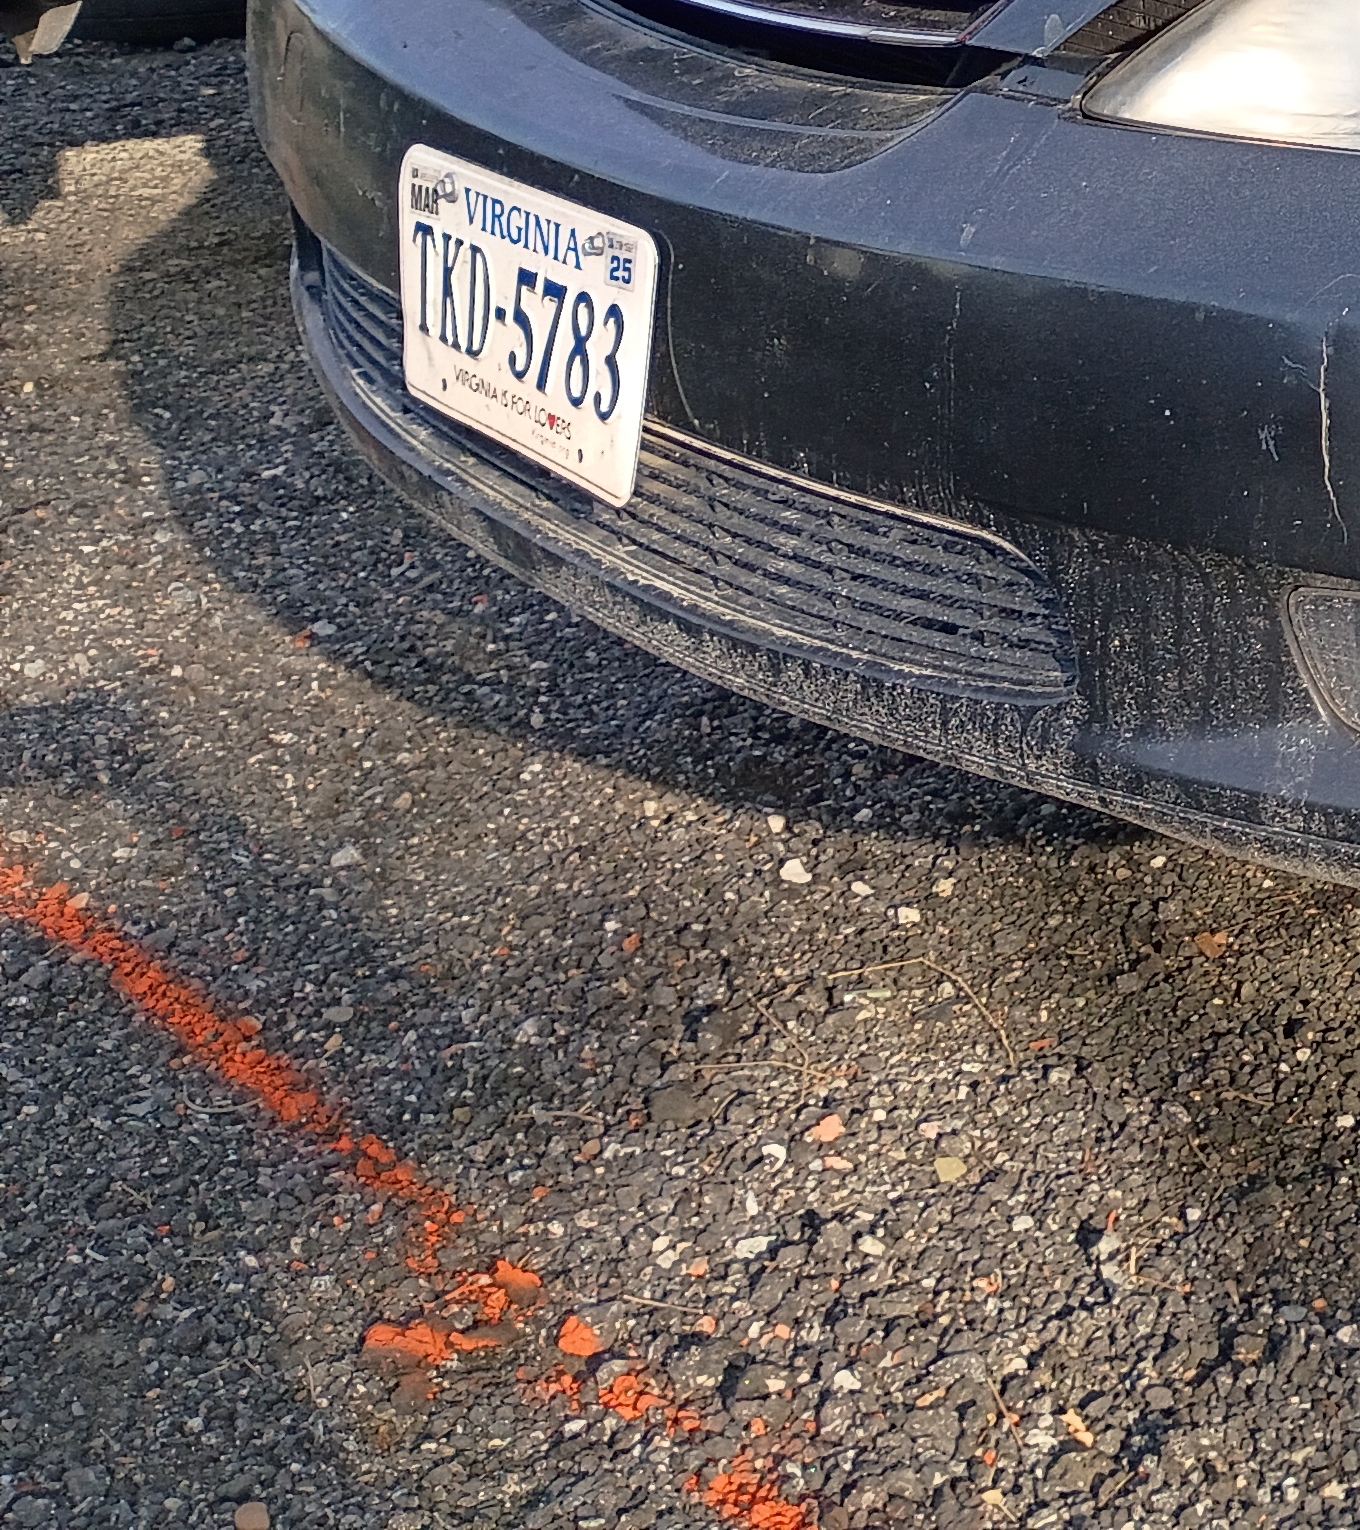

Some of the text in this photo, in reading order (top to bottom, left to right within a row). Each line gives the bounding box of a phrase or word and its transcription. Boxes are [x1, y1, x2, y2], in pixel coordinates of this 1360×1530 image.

[410, 182, 439, 216] MAR
[464, 186, 583, 270] VIRGINIA
[609, 254, 633, 285] 25
[412, 220, 624, 424] TKD-5783
[453, 364, 499, 403] VIRGINIA
[511, 393, 532, 420] FOR
